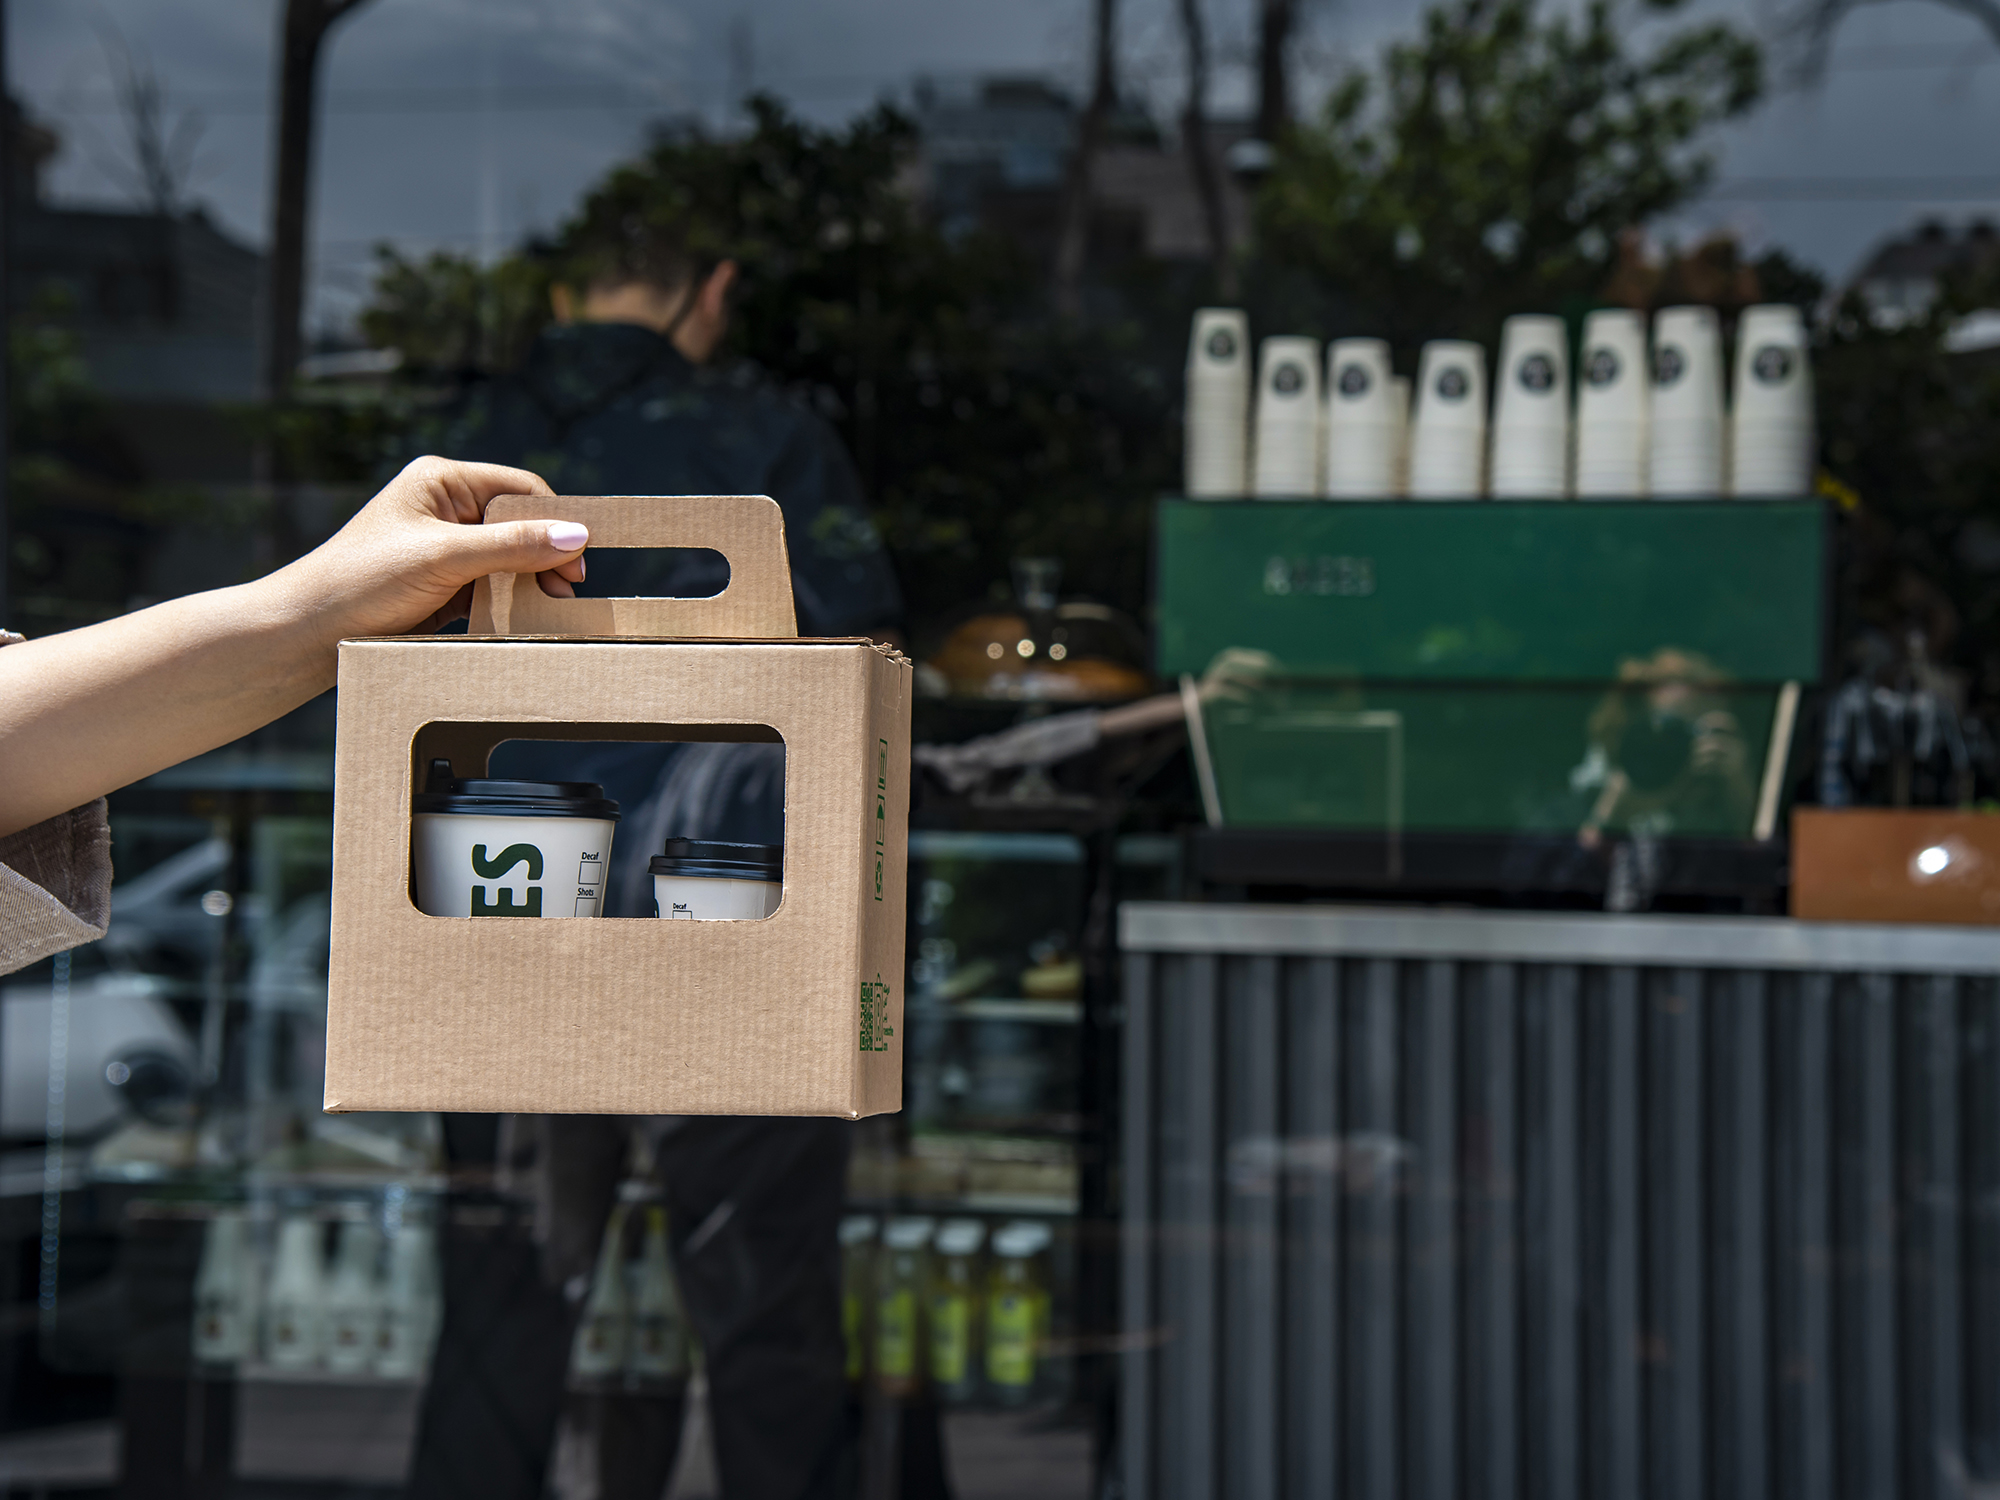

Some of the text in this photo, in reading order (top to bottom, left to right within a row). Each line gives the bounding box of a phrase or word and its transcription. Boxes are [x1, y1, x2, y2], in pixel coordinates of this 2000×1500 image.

[581, 851, 600, 861] Decaf
[471, 843, 544, 917] ES
[577, 887, 595, 896] Shots
[673, 902, 687, 910] Decaf
